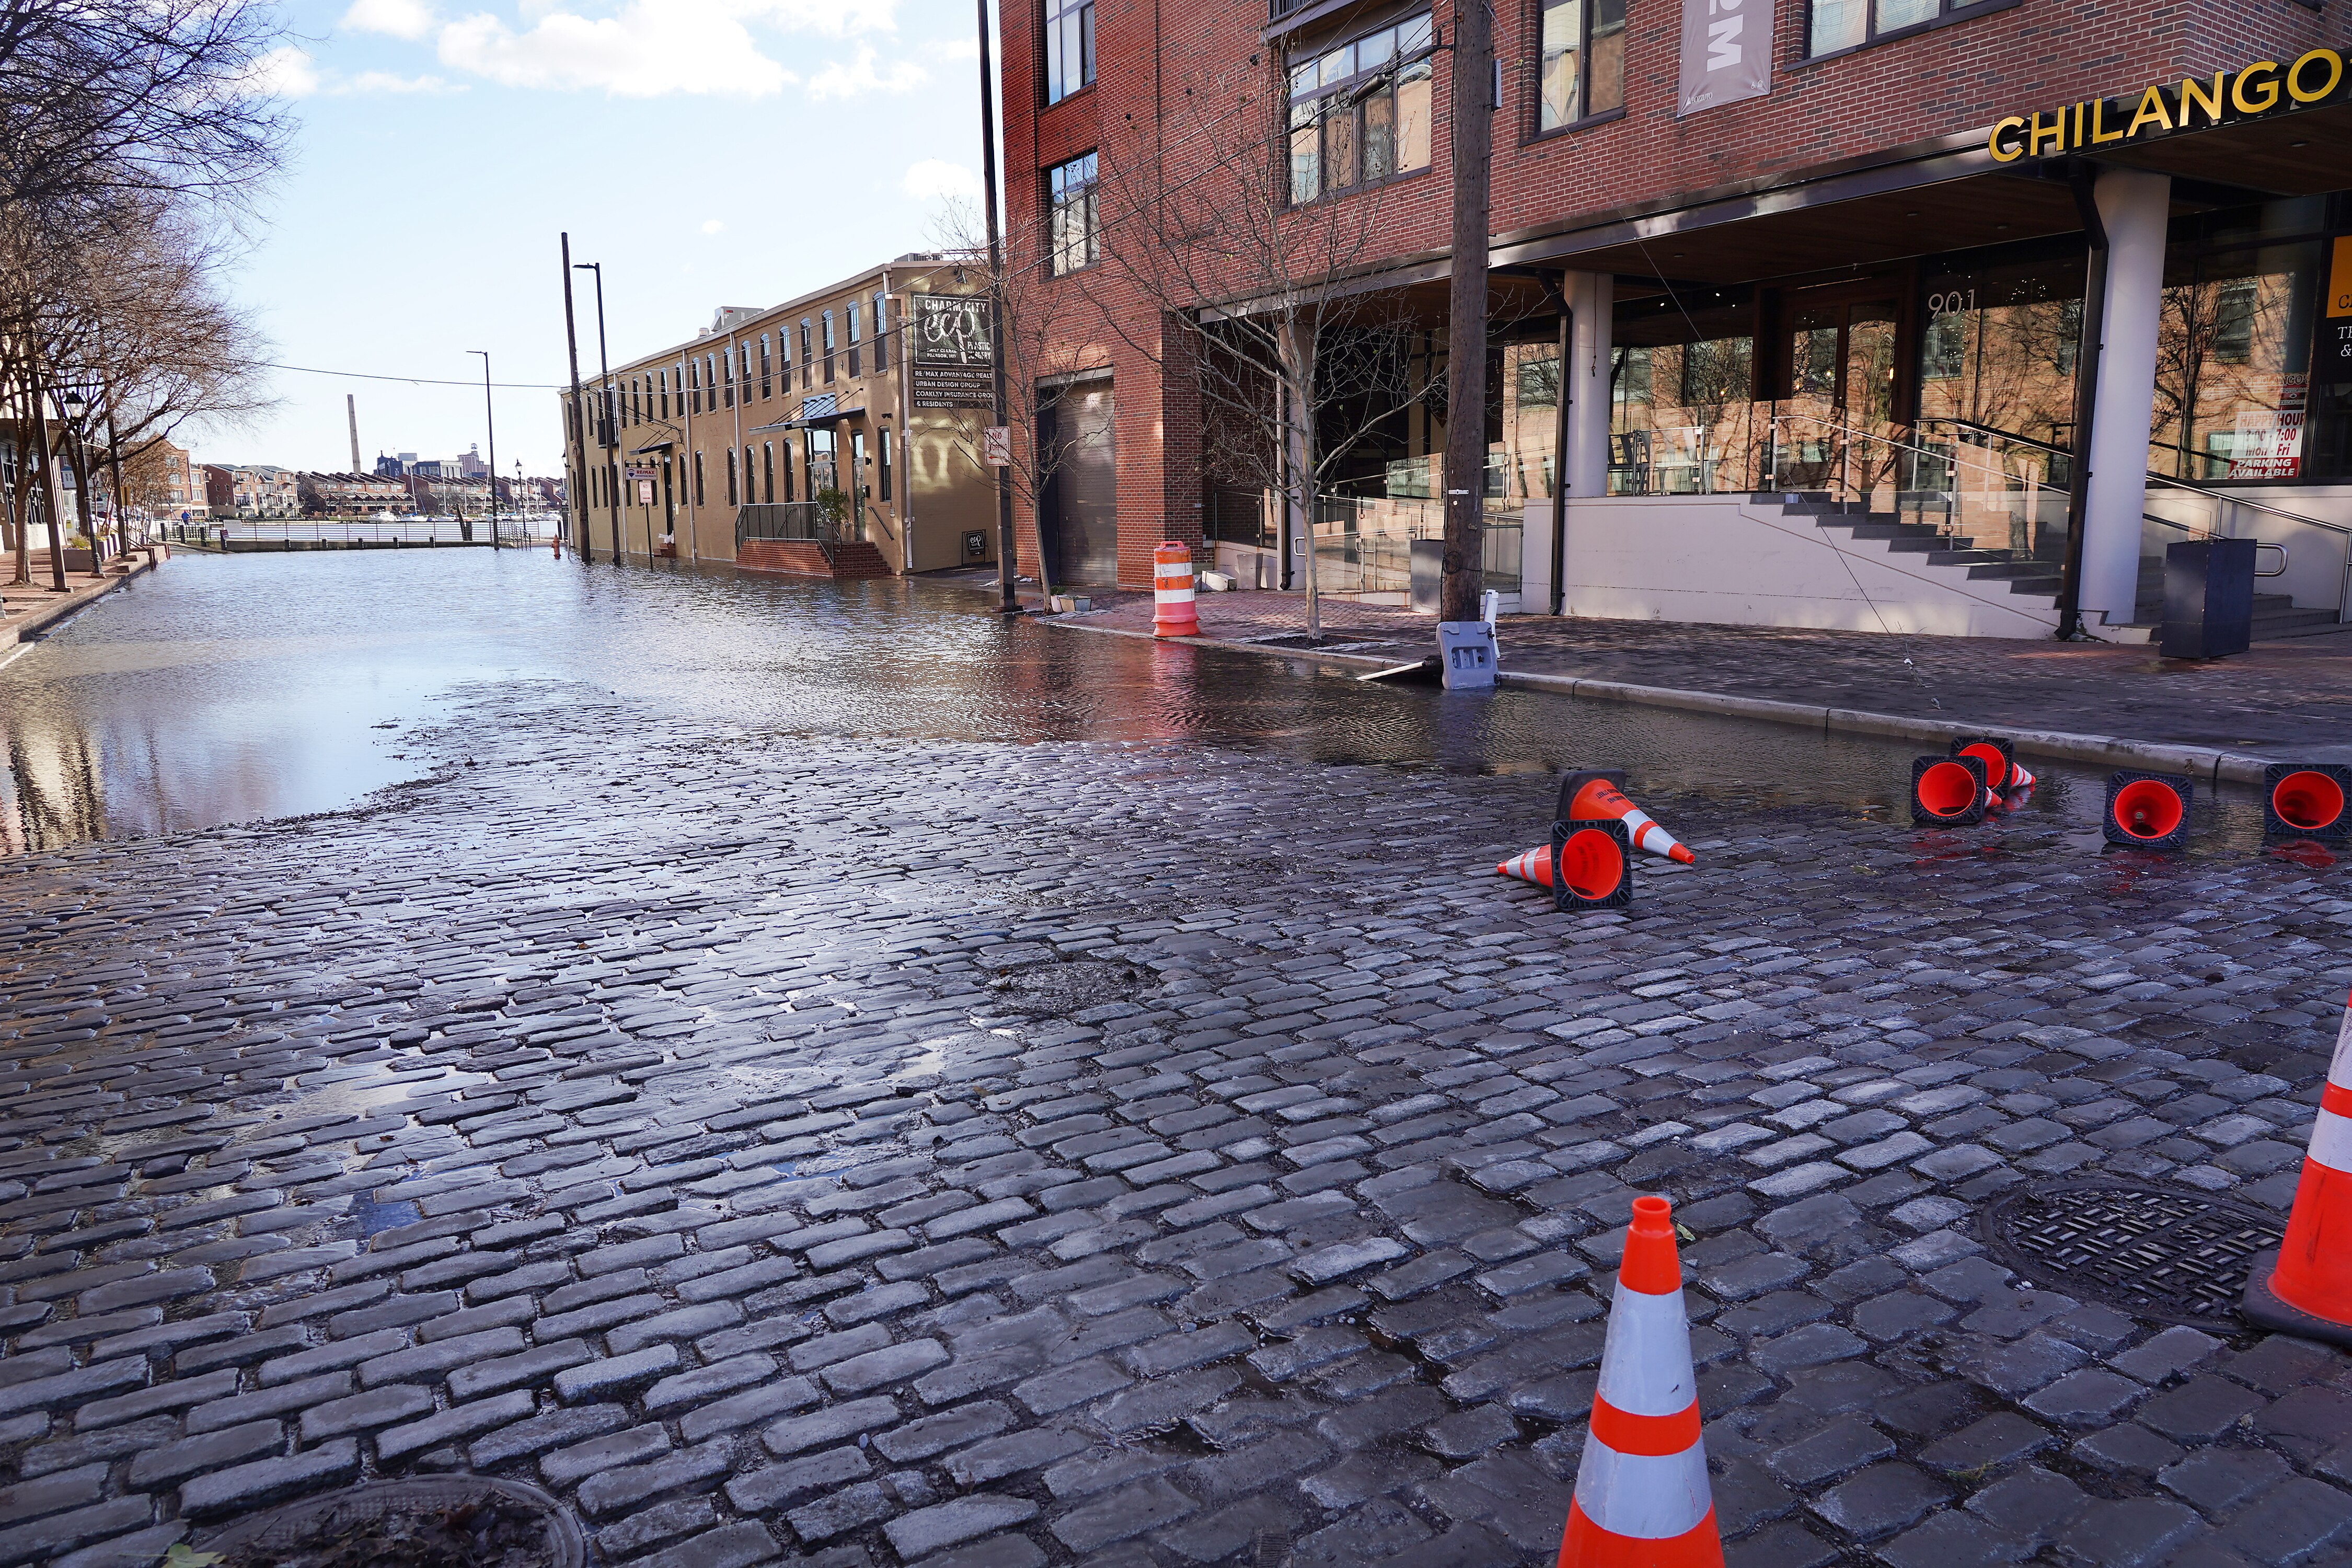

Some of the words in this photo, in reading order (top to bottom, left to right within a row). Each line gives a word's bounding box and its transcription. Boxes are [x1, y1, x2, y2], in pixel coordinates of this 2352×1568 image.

[1691, 92, 1713, 103] BOZZUTO
[1988, 48, 2352, 163] CHILANGO
[925, 299, 961, 311] CHARM
[965, 302, 987, 313] CITY
[1928, 289, 1975, 319] 901
[2240, 414, 2273, 427] HAPPY
[2276, 428, 2297, 441] 7:00
[2245, 445, 2267, 456] Mon
[2276, 443, 2290, 456] Fri
[2236, 458, 2291, 468] PARKING
[2228, 468, 2295, 477] AVAILABLE
